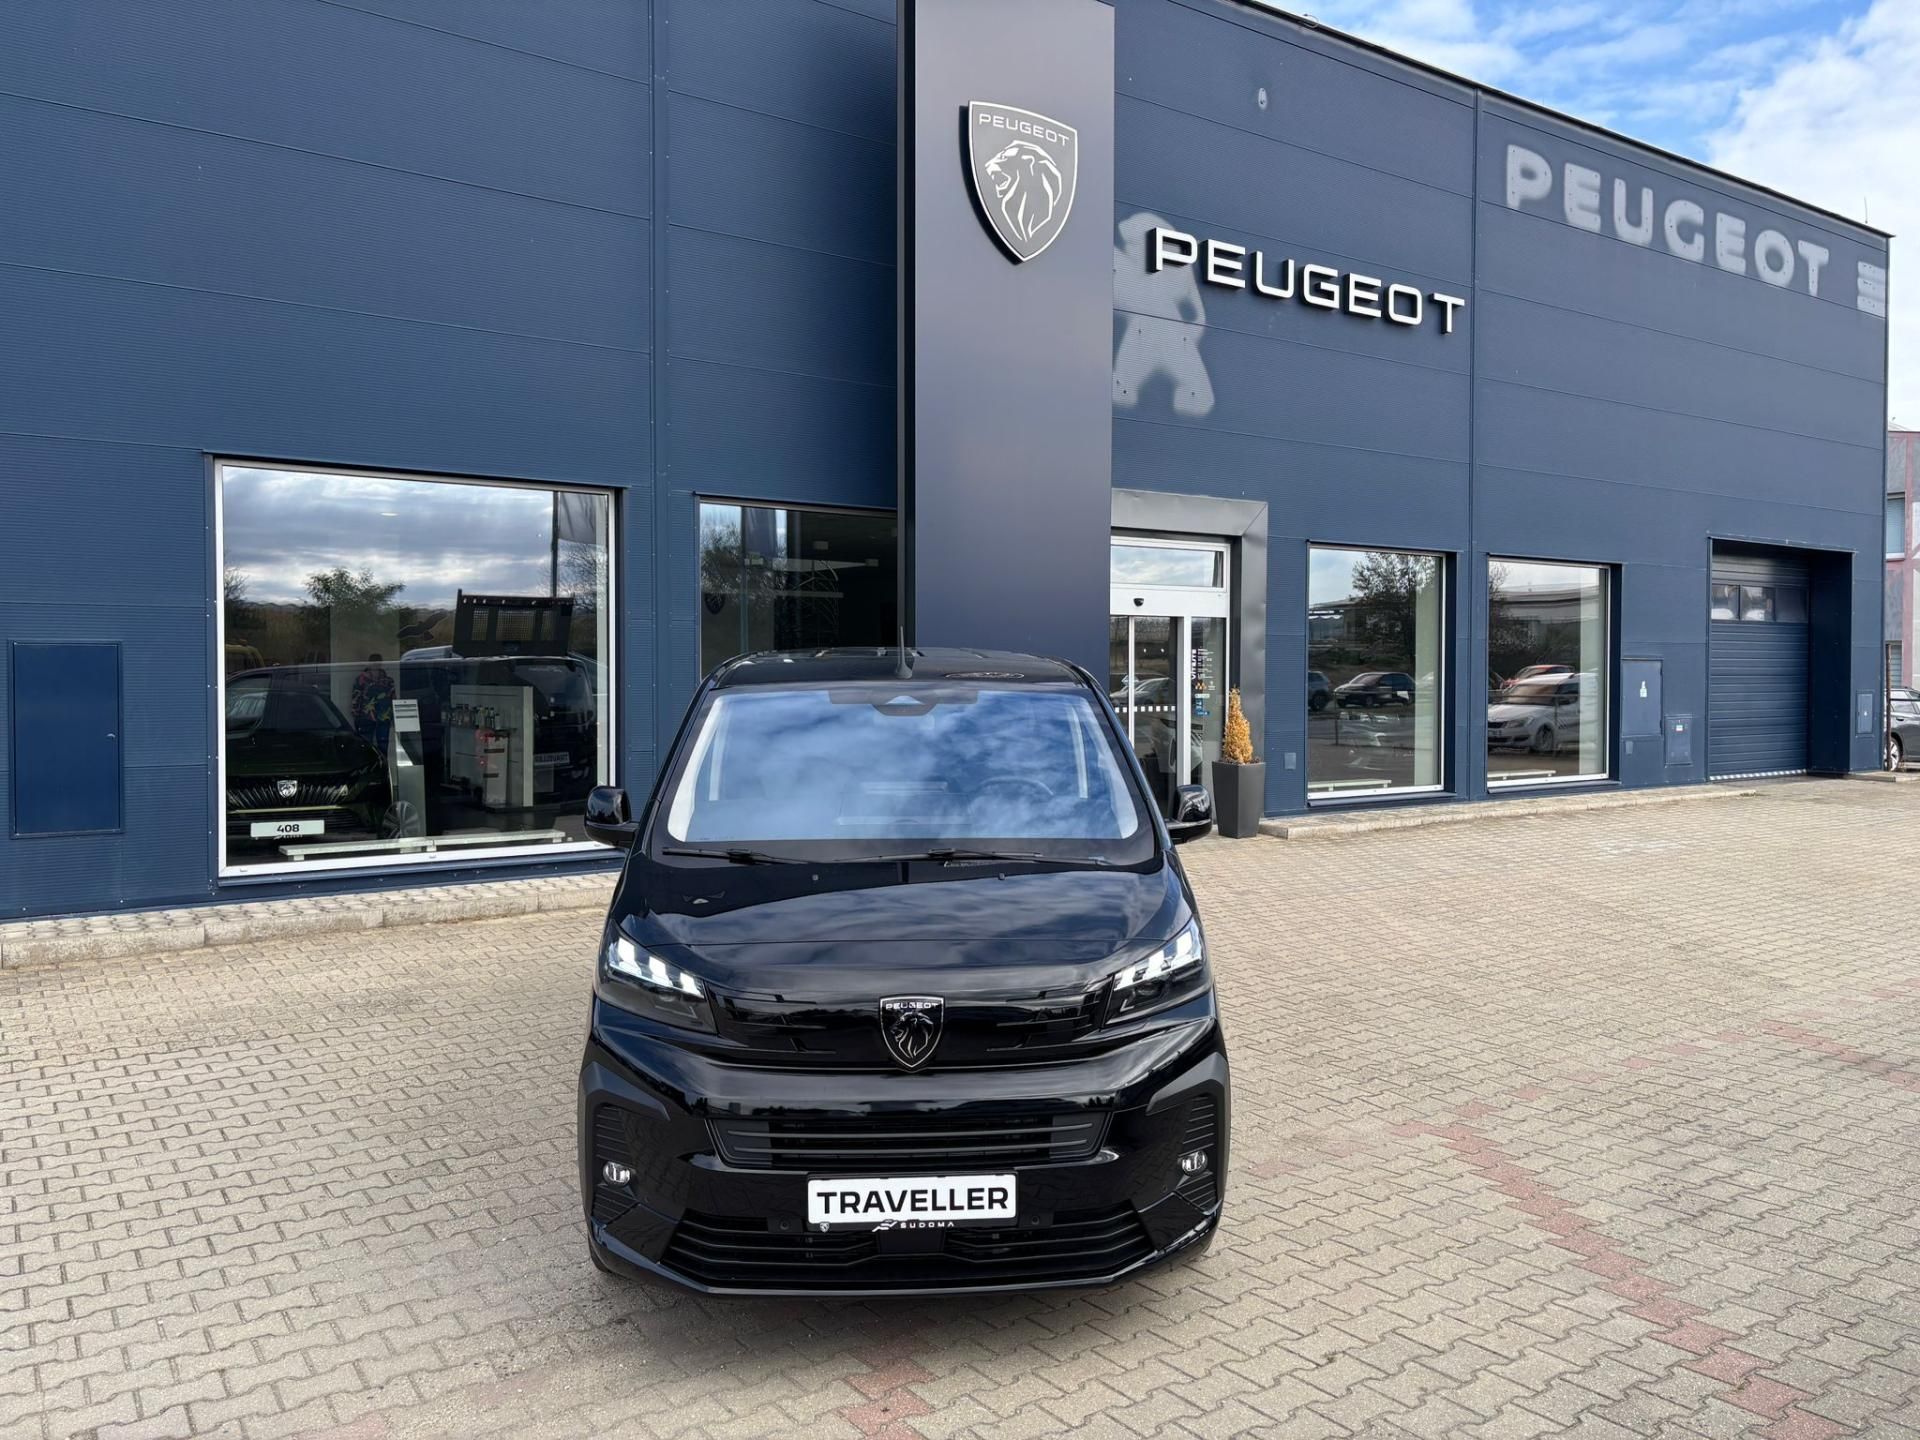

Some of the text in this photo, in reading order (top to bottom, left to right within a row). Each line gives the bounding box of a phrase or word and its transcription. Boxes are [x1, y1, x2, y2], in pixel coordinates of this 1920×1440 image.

[978, 113, 1070, 147] PEUGEOT
[1508, 144, 1829, 297] PEUGEOT
[1152, 226, 1466, 334] PEUGEOT
[277, 824, 300, 833] 408
[885, 1002, 938, 1010] PEUGEOT
[816, 1187, 1009, 1214] TRAVELLER
